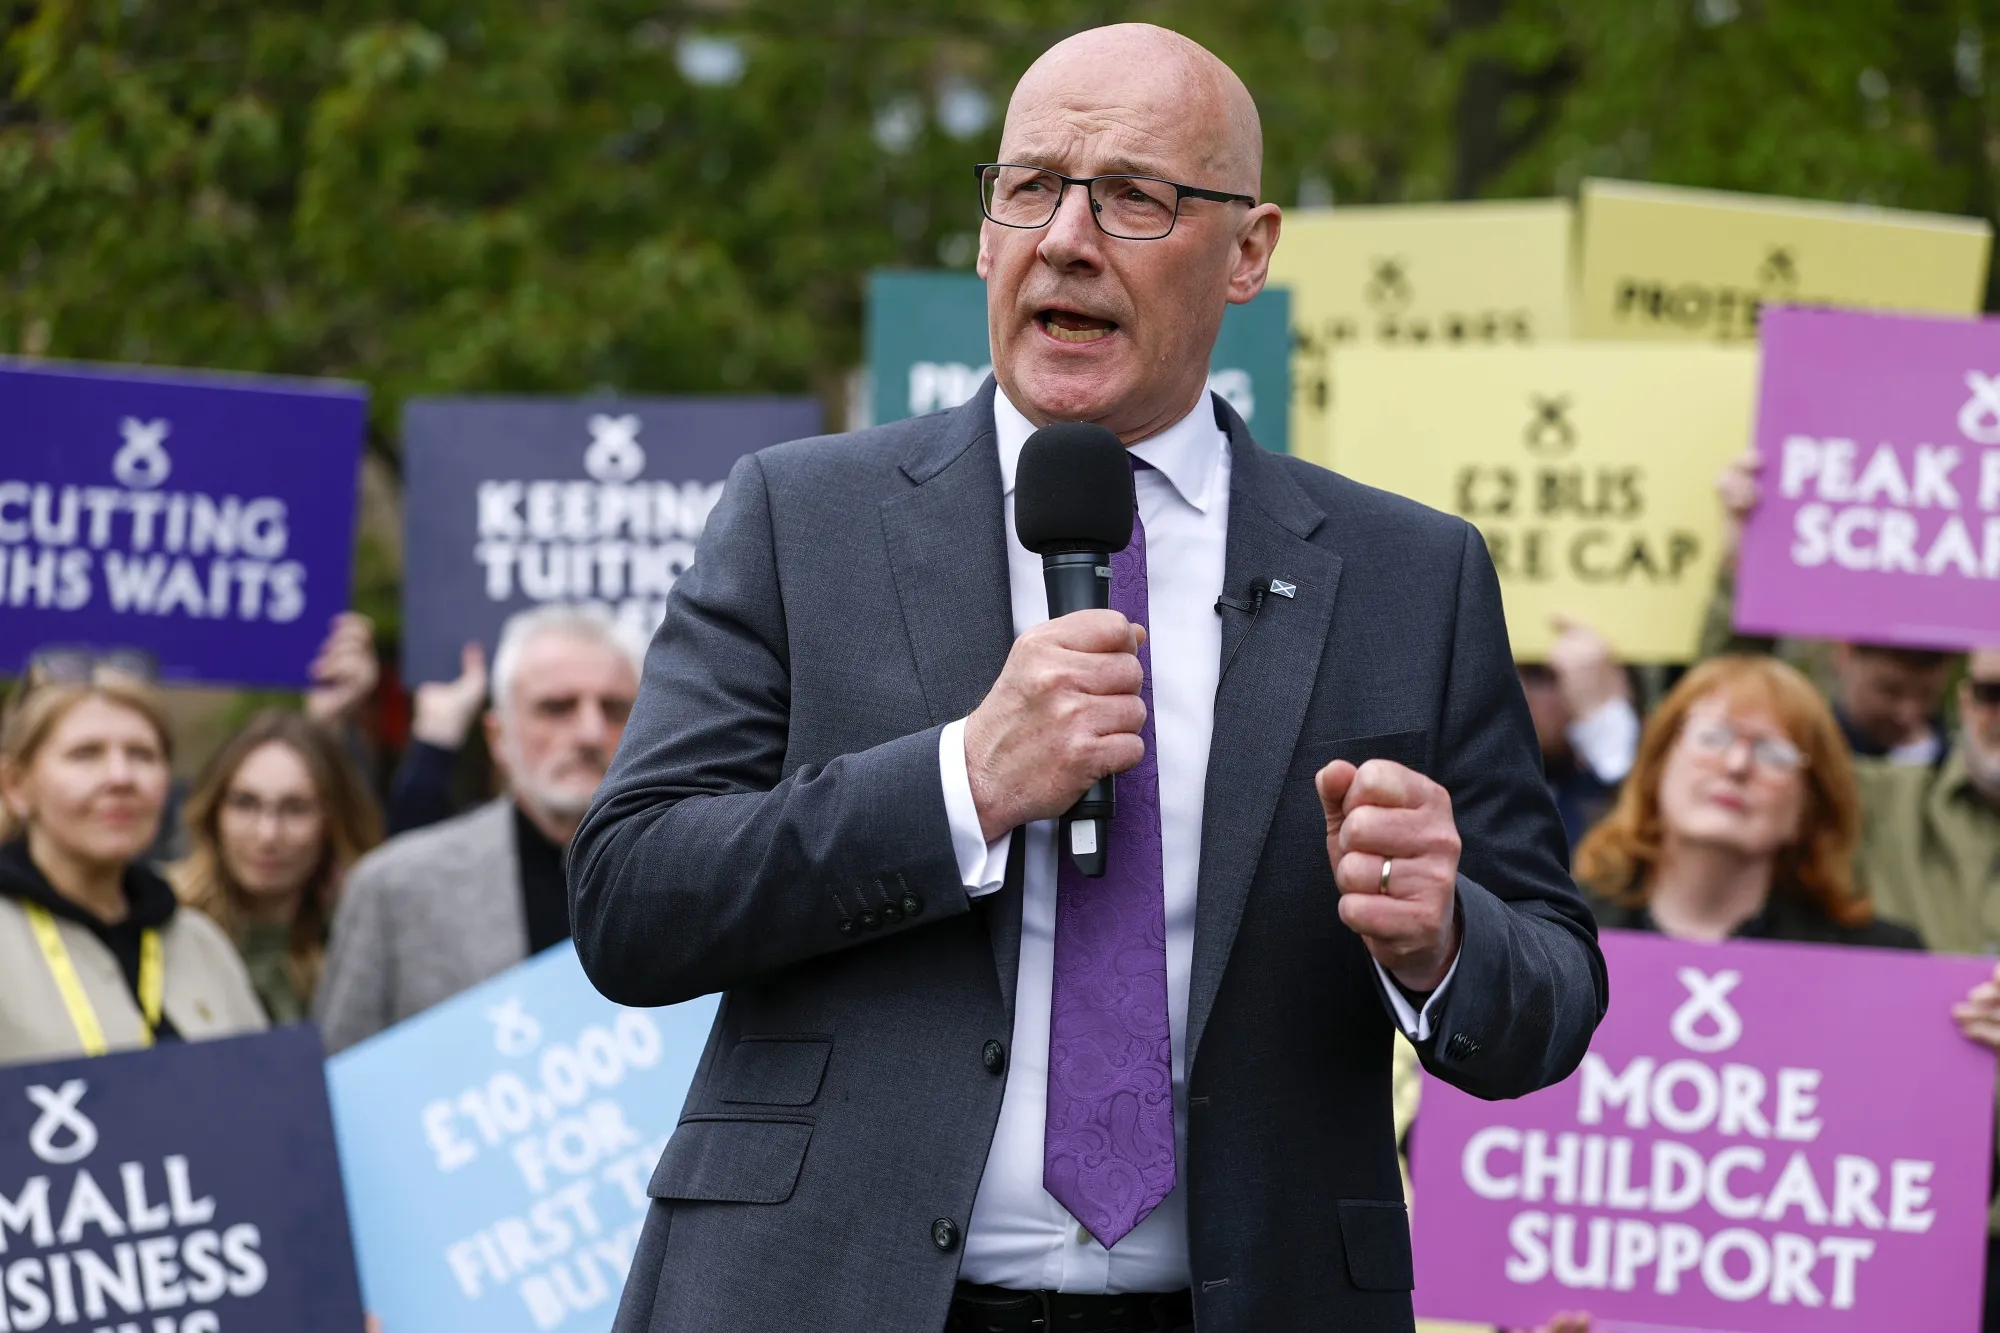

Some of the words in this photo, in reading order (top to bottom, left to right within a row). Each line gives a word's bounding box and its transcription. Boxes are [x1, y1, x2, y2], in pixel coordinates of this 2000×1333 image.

[1456, 465, 1518, 519] £2
[1535, 464, 1646, 520] BUS
[1779, 434, 1964, 511] PEAK
[0, 480, 288, 559] CUTTING
[1567, 527, 1703, 587] CAP
[0, 545, 93, 611] HS
[104, 550, 307, 623] WAITS
[422, 1008, 663, 1172] £10,000
[1577, 1053, 1824, 1141] MORE
[511, 1098, 638, 1193] FOR
[1461, 1125, 1937, 1233] CHILDCARE
[0, 1222, 269, 1333] SINESS
[446, 1180, 600, 1298] FIRST
[1505, 1211, 1876, 1310] SUPPORT
